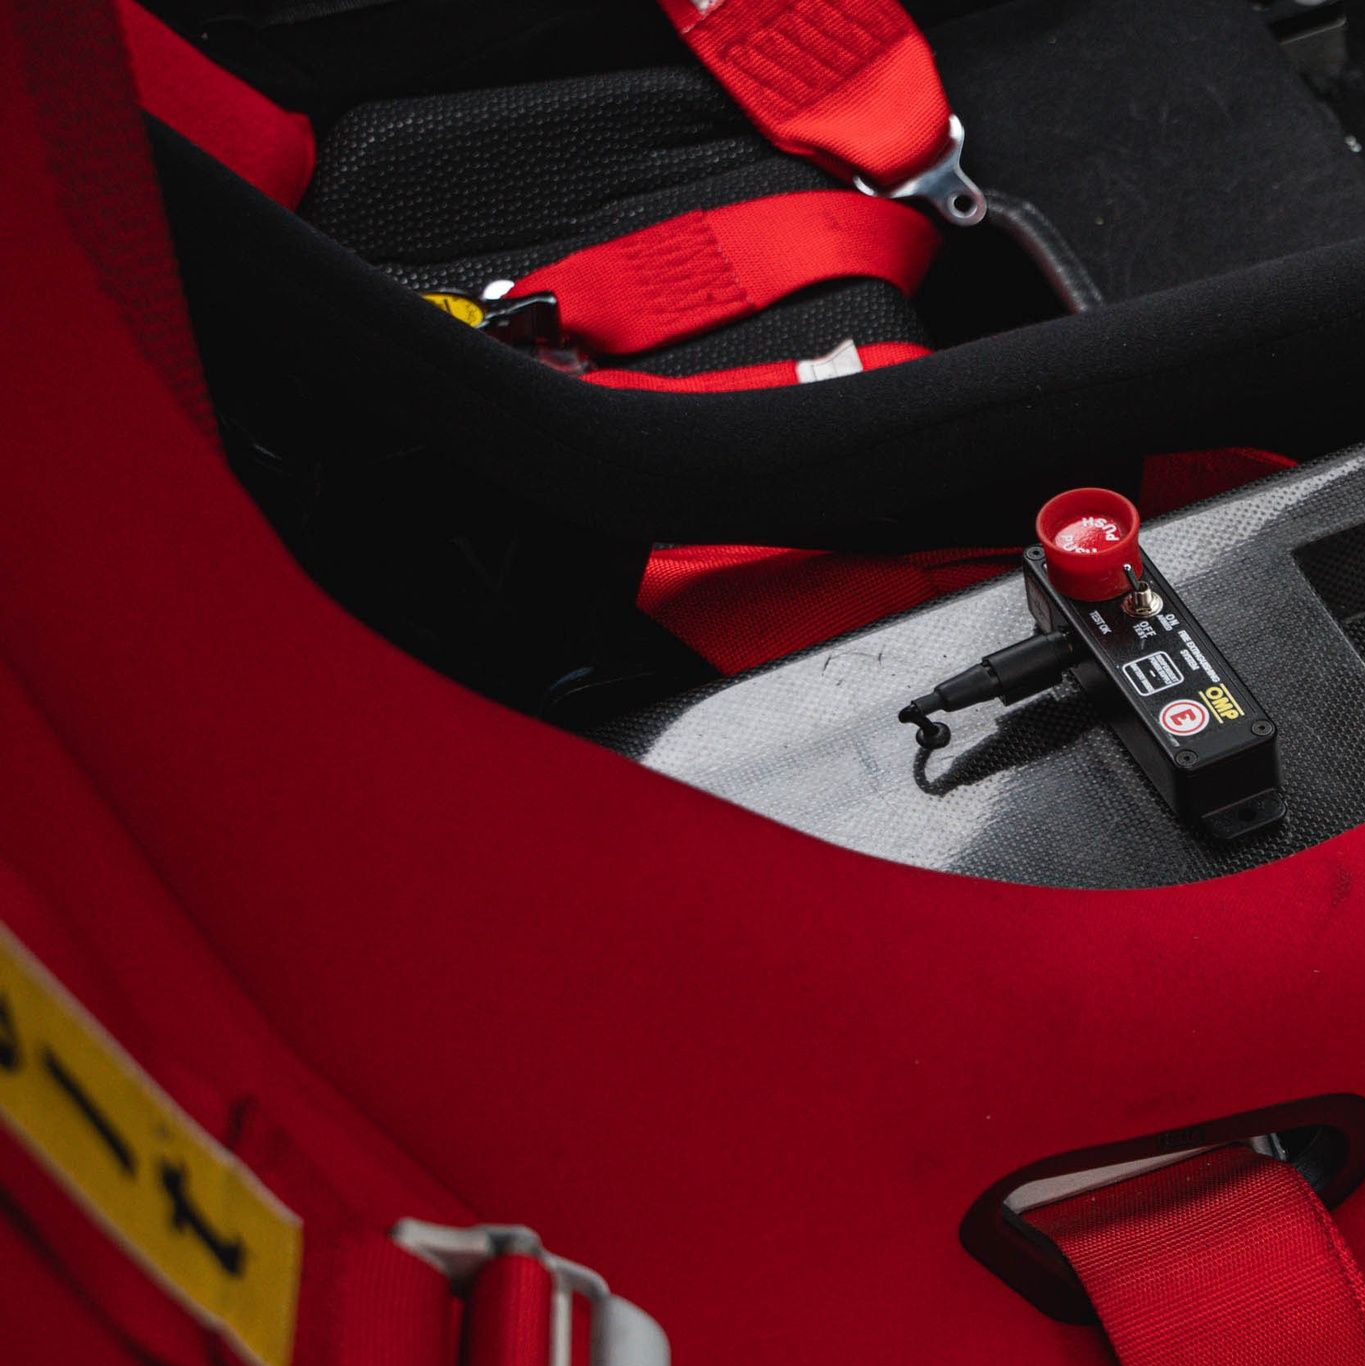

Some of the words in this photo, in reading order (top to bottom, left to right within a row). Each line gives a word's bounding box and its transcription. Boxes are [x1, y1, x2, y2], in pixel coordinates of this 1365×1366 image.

[1081, 516, 1119, 541] PUSH
[1089, 610, 1104, 625] TEST
[1098, 622, 1111, 634] OK
[1139, 619, 1156, 637] OFF
[1164, 611, 1179, 627] ON
[1132, 623, 1147, 640] TEST
[1179, 649, 1199, 670] SYSTEM
[1185, 639, 1220, 683] EXTINGUISHING
[1203, 683, 1239, 722] OMP
[1169, 707, 1195, 726] E
